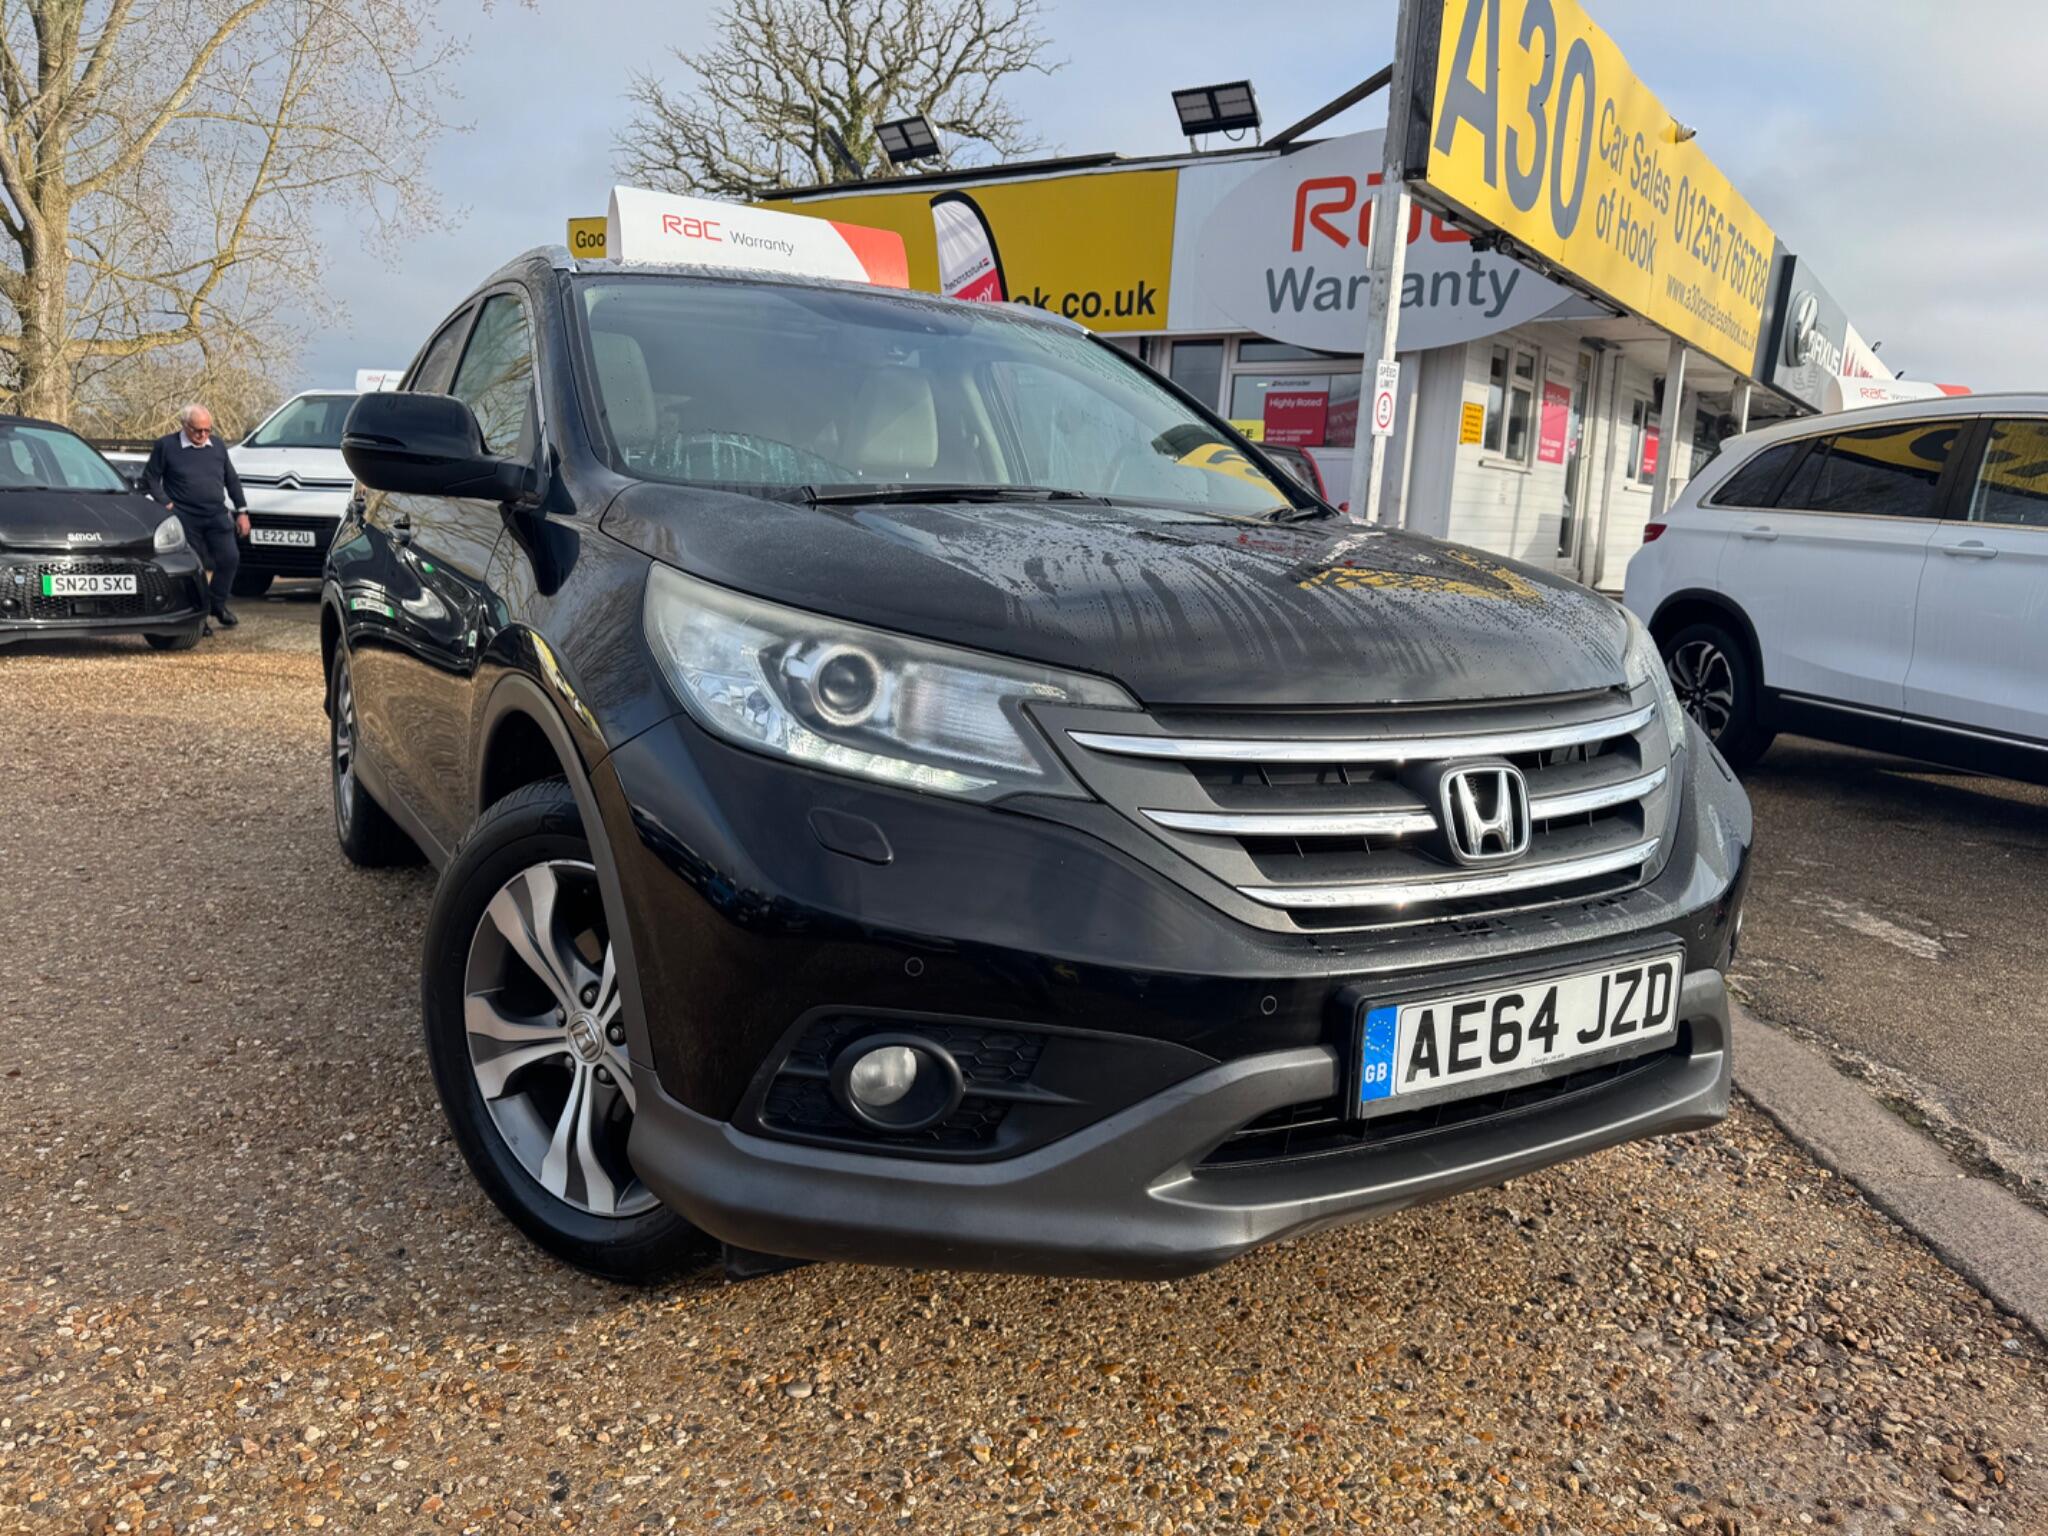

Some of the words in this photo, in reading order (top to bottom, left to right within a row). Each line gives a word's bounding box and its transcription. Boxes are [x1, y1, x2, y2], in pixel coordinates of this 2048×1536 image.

[1433, 0, 1595, 240] A30
[1599, 97, 1628, 176] Car
[1630, 131, 1671, 215] Sales
[575, 230, 606, 249] Goo
[729, 230, 795, 256] Warranty
[1596, 187, 1616, 244] of
[1616, 195, 1657, 275] Hook
[1674, 175, 1724, 273] 01256
[1722, 222, 1769, 312] 766788
[1265, 258, 1521, 319] Waranty
[1269, 397, 1295, 409] Highly
[1297, 397, 1323, 407] Rated
[255, 530, 285, 543] LE22
[287, 532, 311, 544] CZU
[55, 577, 99, 592] SN20
[103, 577, 133, 591] SXC
[1405, 986, 1559, 1084] AE64
[1576, 962, 1673, 1046] JZD
[1365, 1062, 1387, 1084] GB
